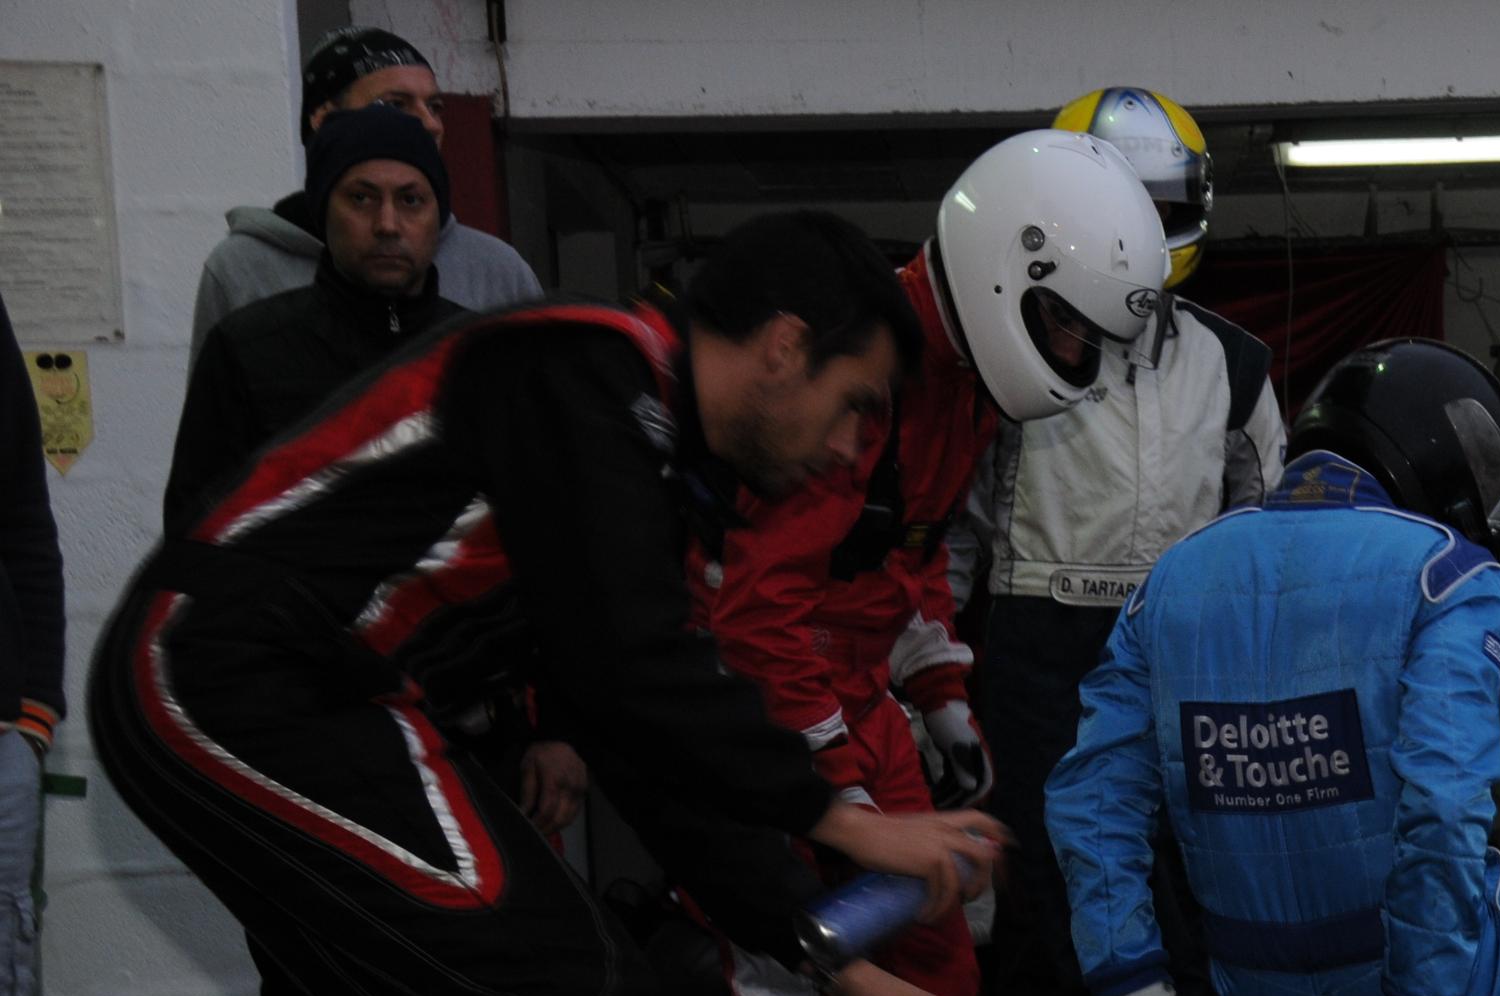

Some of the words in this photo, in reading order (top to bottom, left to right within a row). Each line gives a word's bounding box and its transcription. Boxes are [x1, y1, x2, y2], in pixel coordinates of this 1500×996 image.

[1193, 713, 1329, 749] Deloitte
[1198, 753, 1225, 788] &
[1226, 746, 1351, 788] Touche
[1214, 792, 1271, 808] Number
[1275, 791, 1302, 806] One
[1306, 785, 1340, 801] Firm
